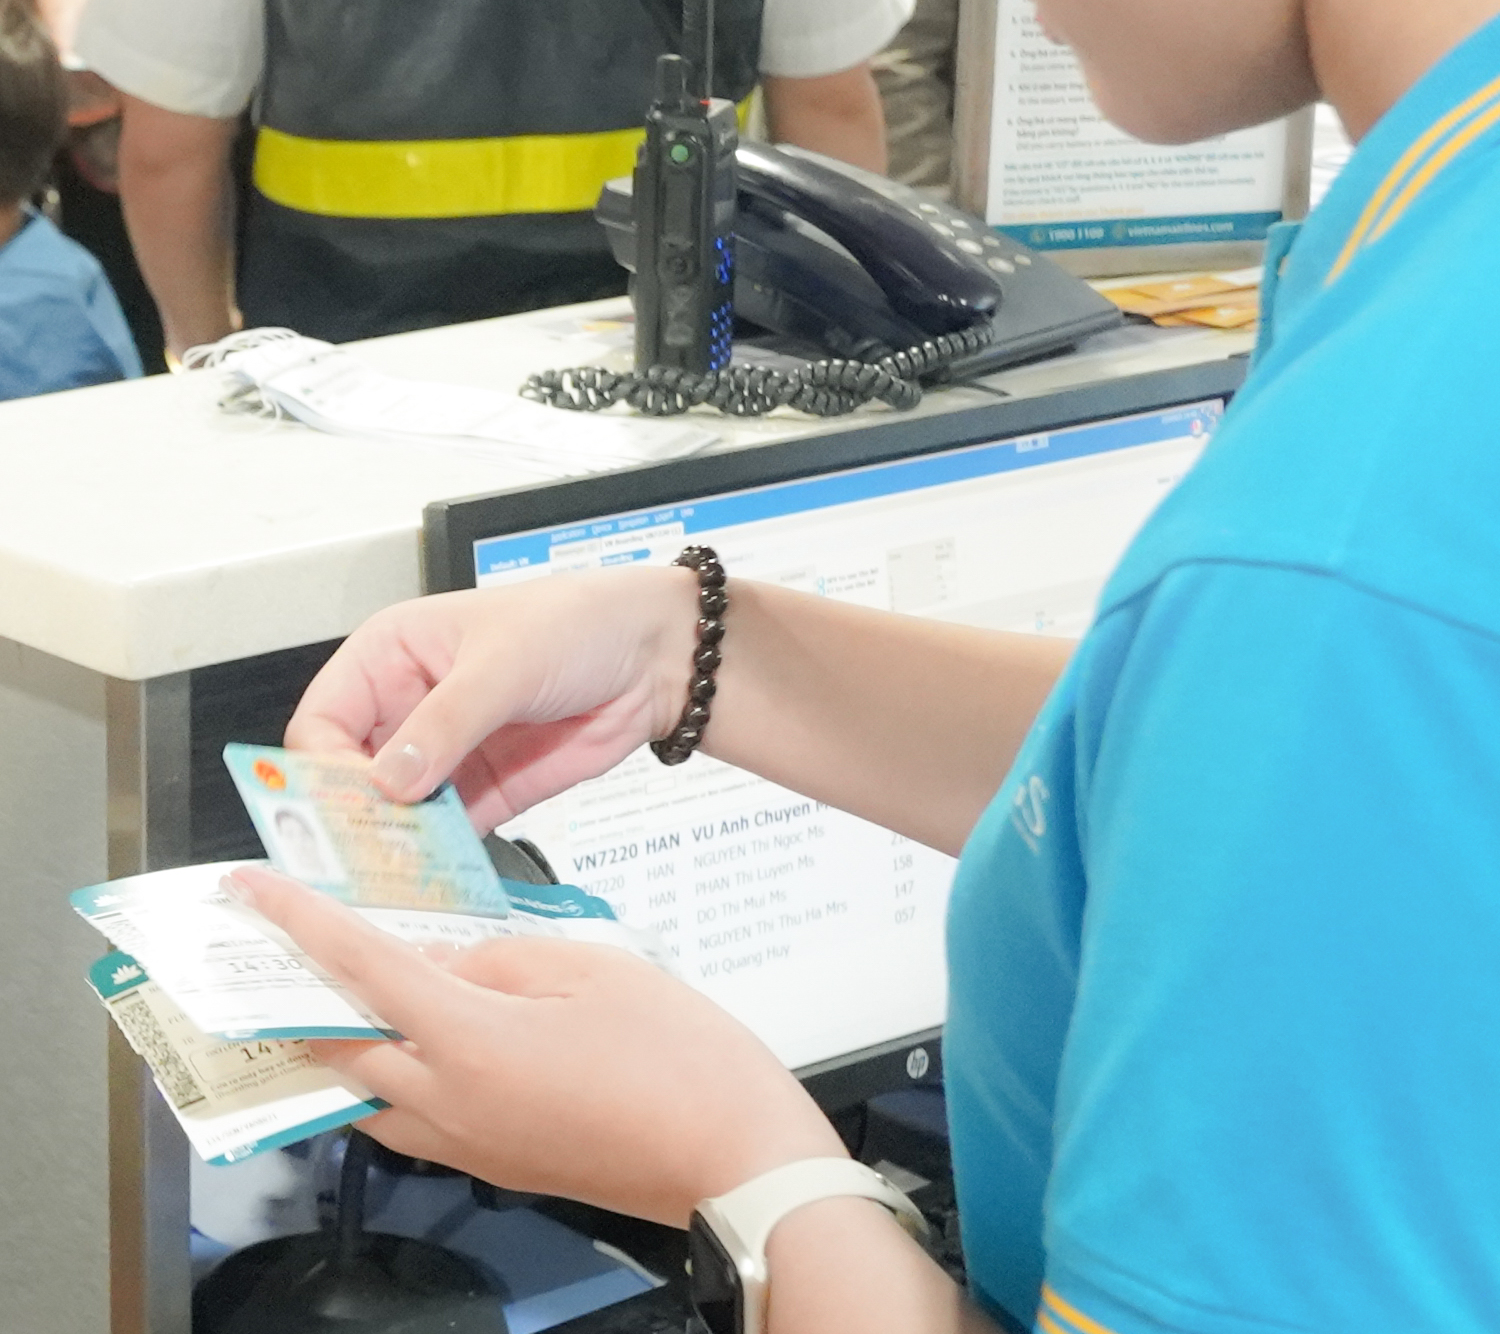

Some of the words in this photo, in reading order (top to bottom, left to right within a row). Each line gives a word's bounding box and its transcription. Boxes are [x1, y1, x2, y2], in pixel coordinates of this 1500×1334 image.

[572, 843, 638, 874] VN7220
[645, 832, 681, 856] HAN
[691, 823, 715, 843] VU
[719, 814, 750, 837] Anh
[753, 800, 812, 828] Chuyen
[583, 874, 625, 897] N7220
[646, 862, 676, 882] HAN
[693, 846, 747, 870] NGUYEN
[751, 836, 770, 855] Thi
[773, 829, 804, 851] Ngoc
[807, 824, 826, 840] Ms
[648, 890, 677, 909] HAN
[695, 876, 730, 896] PHAN
[735, 866, 754, 884] Thi
[757, 859, 794, 882] Luyen
[797, 853, 816, 869] Ms
[892, 854, 913, 871] 158
[696, 905, 717, 924] DO
[721, 898, 741, 917] Thi
[743, 892, 767, 910] Mui
[769, 887, 788, 903] Ms
[894, 879, 915, 898] 147
[698, 926, 752, 952] NGUYEN
[756, 918, 775, 936] Thi
[778, 910, 802, 930] Thu
[805, 905, 822, 921] Ha
[825, 899, 848, 916] Mrs
[893, 906, 917, 925] 057
[228, 957, 303, 974] 14:30
[700, 960, 718, 979] VU
[721, 950, 763, 976] Quang
[766, 941, 792, 962] Huy
